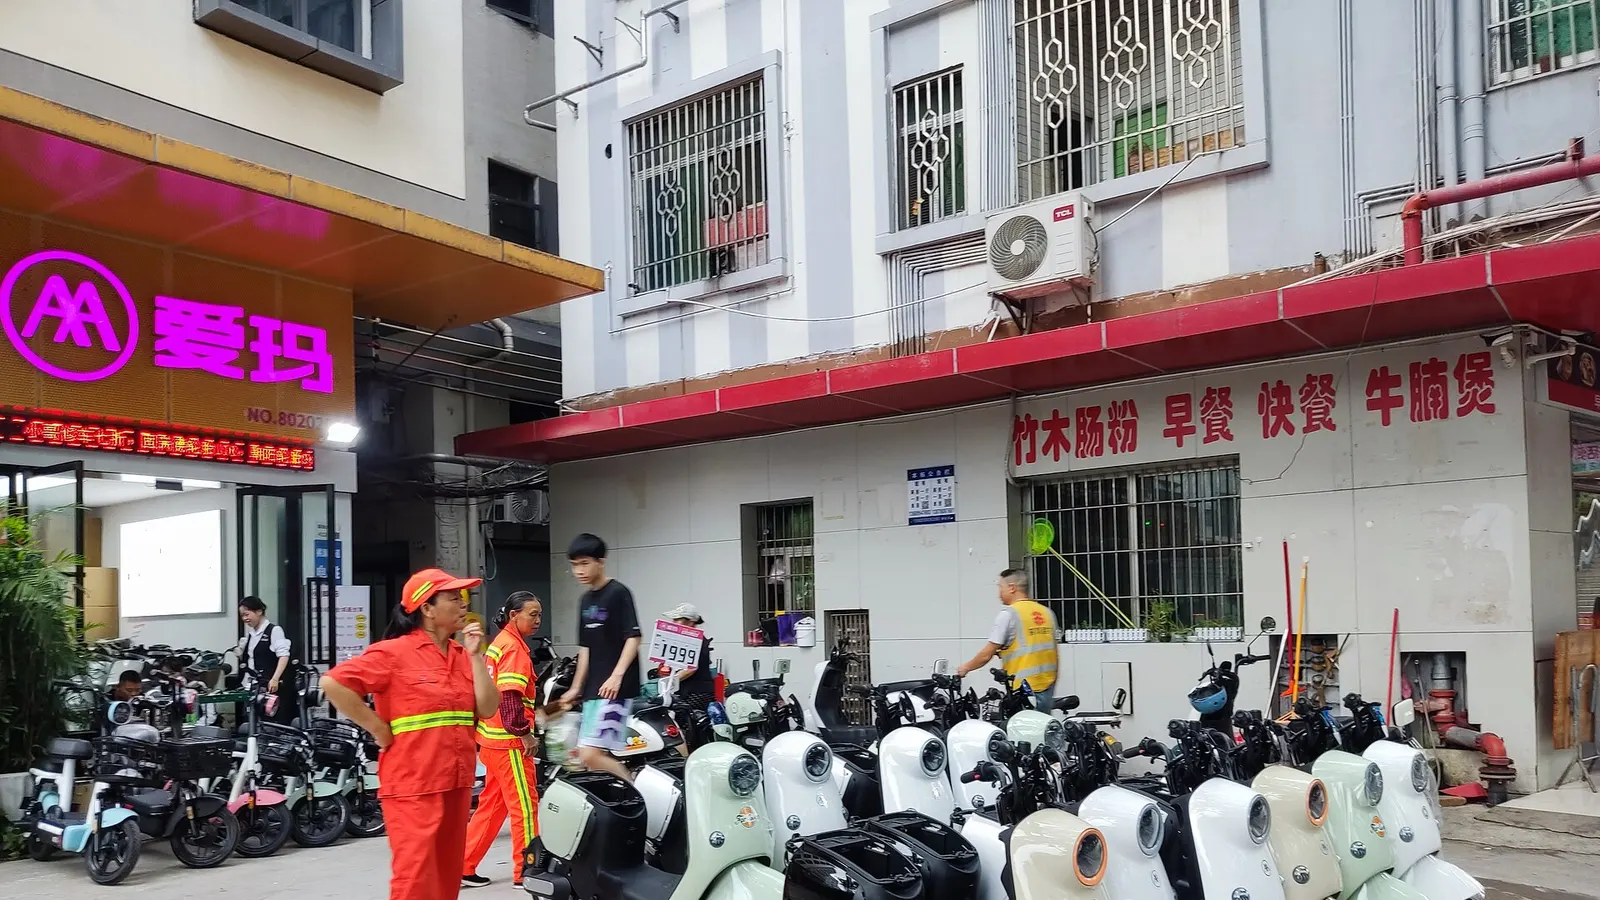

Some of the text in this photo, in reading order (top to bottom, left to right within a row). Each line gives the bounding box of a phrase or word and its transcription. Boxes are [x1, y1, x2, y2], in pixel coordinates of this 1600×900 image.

[1055, 209, 1073, 218] TCL
[154, 295, 334, 394] 爱玛
[1012, 351, 1496, 466] 竹木肠粉 早餐 快餐 牛腩煲
[661, 643, 696, 665] 1999
